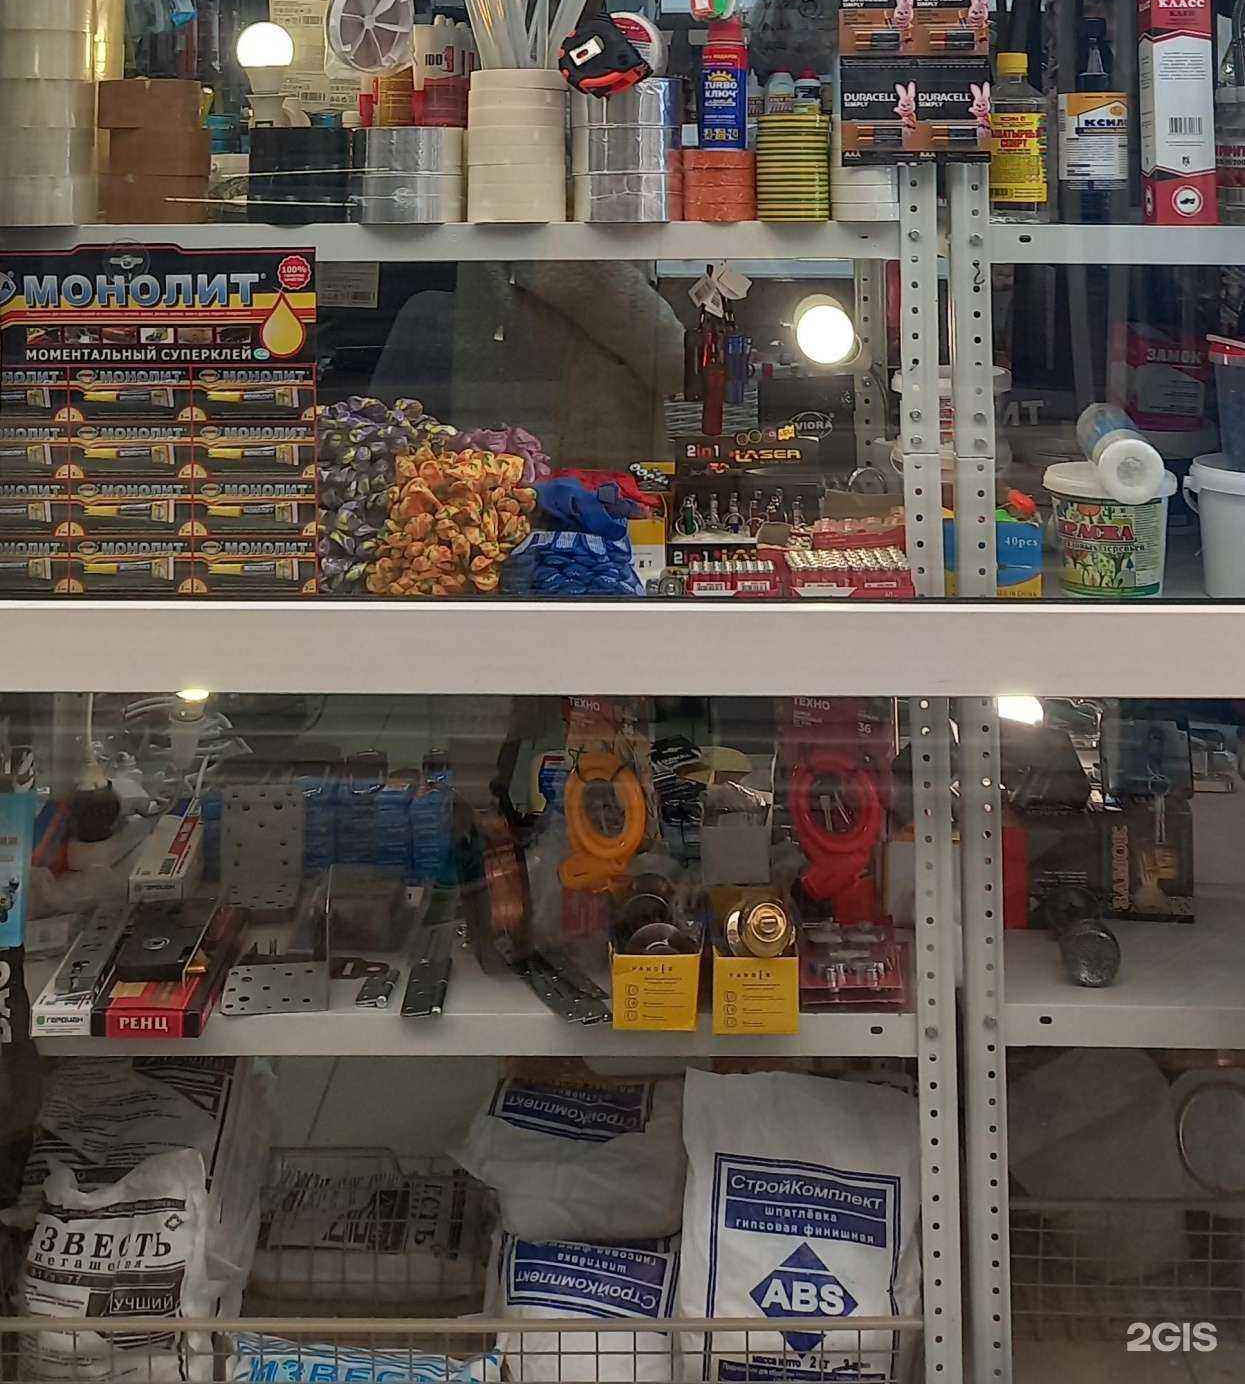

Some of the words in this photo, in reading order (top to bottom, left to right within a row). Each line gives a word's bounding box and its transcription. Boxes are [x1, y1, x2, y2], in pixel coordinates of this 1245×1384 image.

[1158, 0, 1206, 8] КЛАСС
[704, 81, 738, 89] TURBO
[704, 90, 737, 98] КЛЮЧ
[843, 92, 896, 102] DURACELL
[918, 93, 971, 102] DURACELL
[282, 265, 307, 274] 100%
[23, 274, 260, 307] МОНОЛИТ
[26, 346, 157, 361] МОМЕНТАЛЬНЫЙ
[161, 346, 252, 360] СУПЕРКЛЕЙ
[100, 371, 182, 384] МОНОЛИТ
[222, 370, 306, 382] МОНОЛИТ
[101, 428, 184, 440] МОНОЛИТ
[223, 427, 308, 440] МОНОЛИТ
[686, 444, 720, 458] 2in1
[735, 449, 801, 463] LASER
[101, 484, 185, 496] МОНОЛИТ
[224, 484, 309, 496] МОНОЛИТ
[101, 542, 185, 554] МОНОЛИТ
[224, 542, 309, 554] МОНОЛИТ
[568, 696, 601, 713] ТЕХНО
[857, 722, 872, 734] 36
[119, 1016, 169, 1032] РЕНЦ
[730, 1175, 884, 1210] СтройКомплект
[764, 1207, 838, 1222] шпатлёвка
[735, 1218, 798, 1233] гипсовая
[803, 1223, 875, 1244] финишная
[516, 1271, 656, 1310] СтройКомплект
[760, 1278, 845, 1316] ABS
